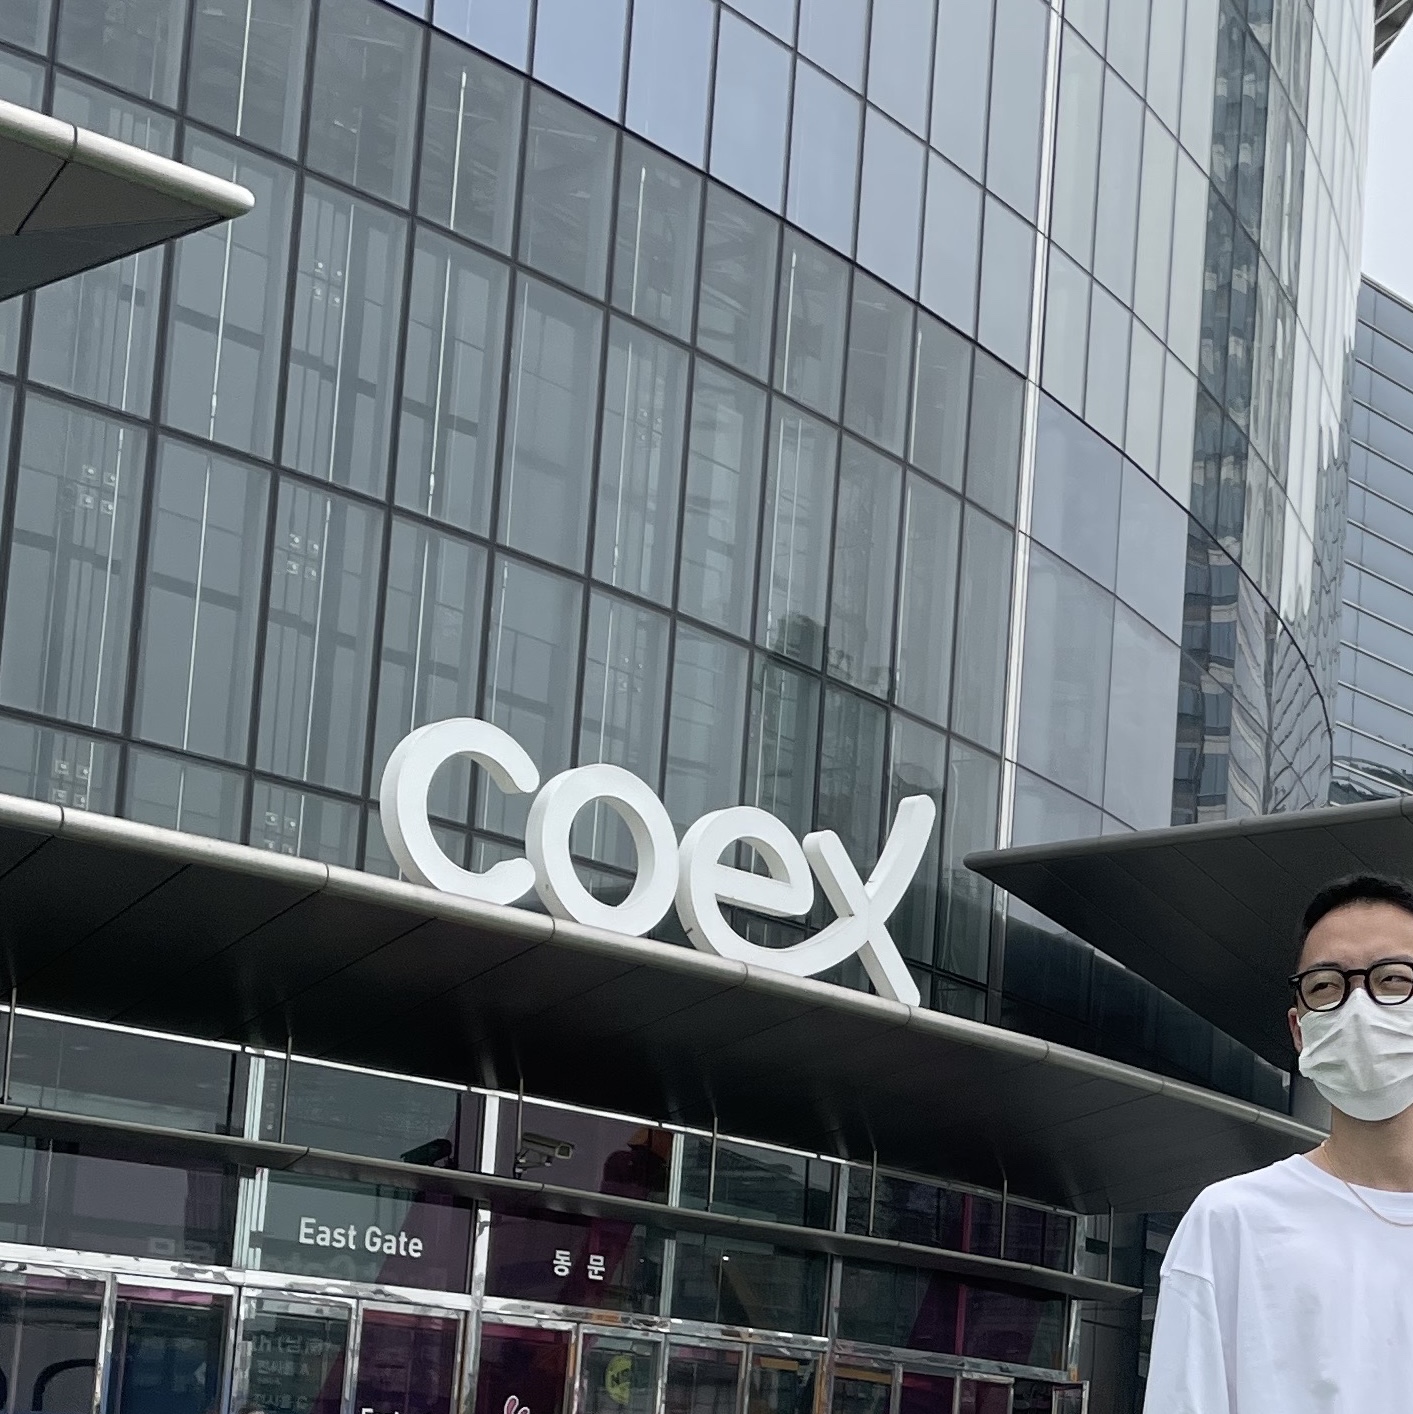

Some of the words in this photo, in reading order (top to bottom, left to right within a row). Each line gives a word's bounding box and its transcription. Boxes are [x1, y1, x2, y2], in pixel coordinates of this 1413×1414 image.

[381, 717, 936, 1006] coex
[299, 1216, 357, 1250] East
[364, 1225, 423, 1258] Gate
